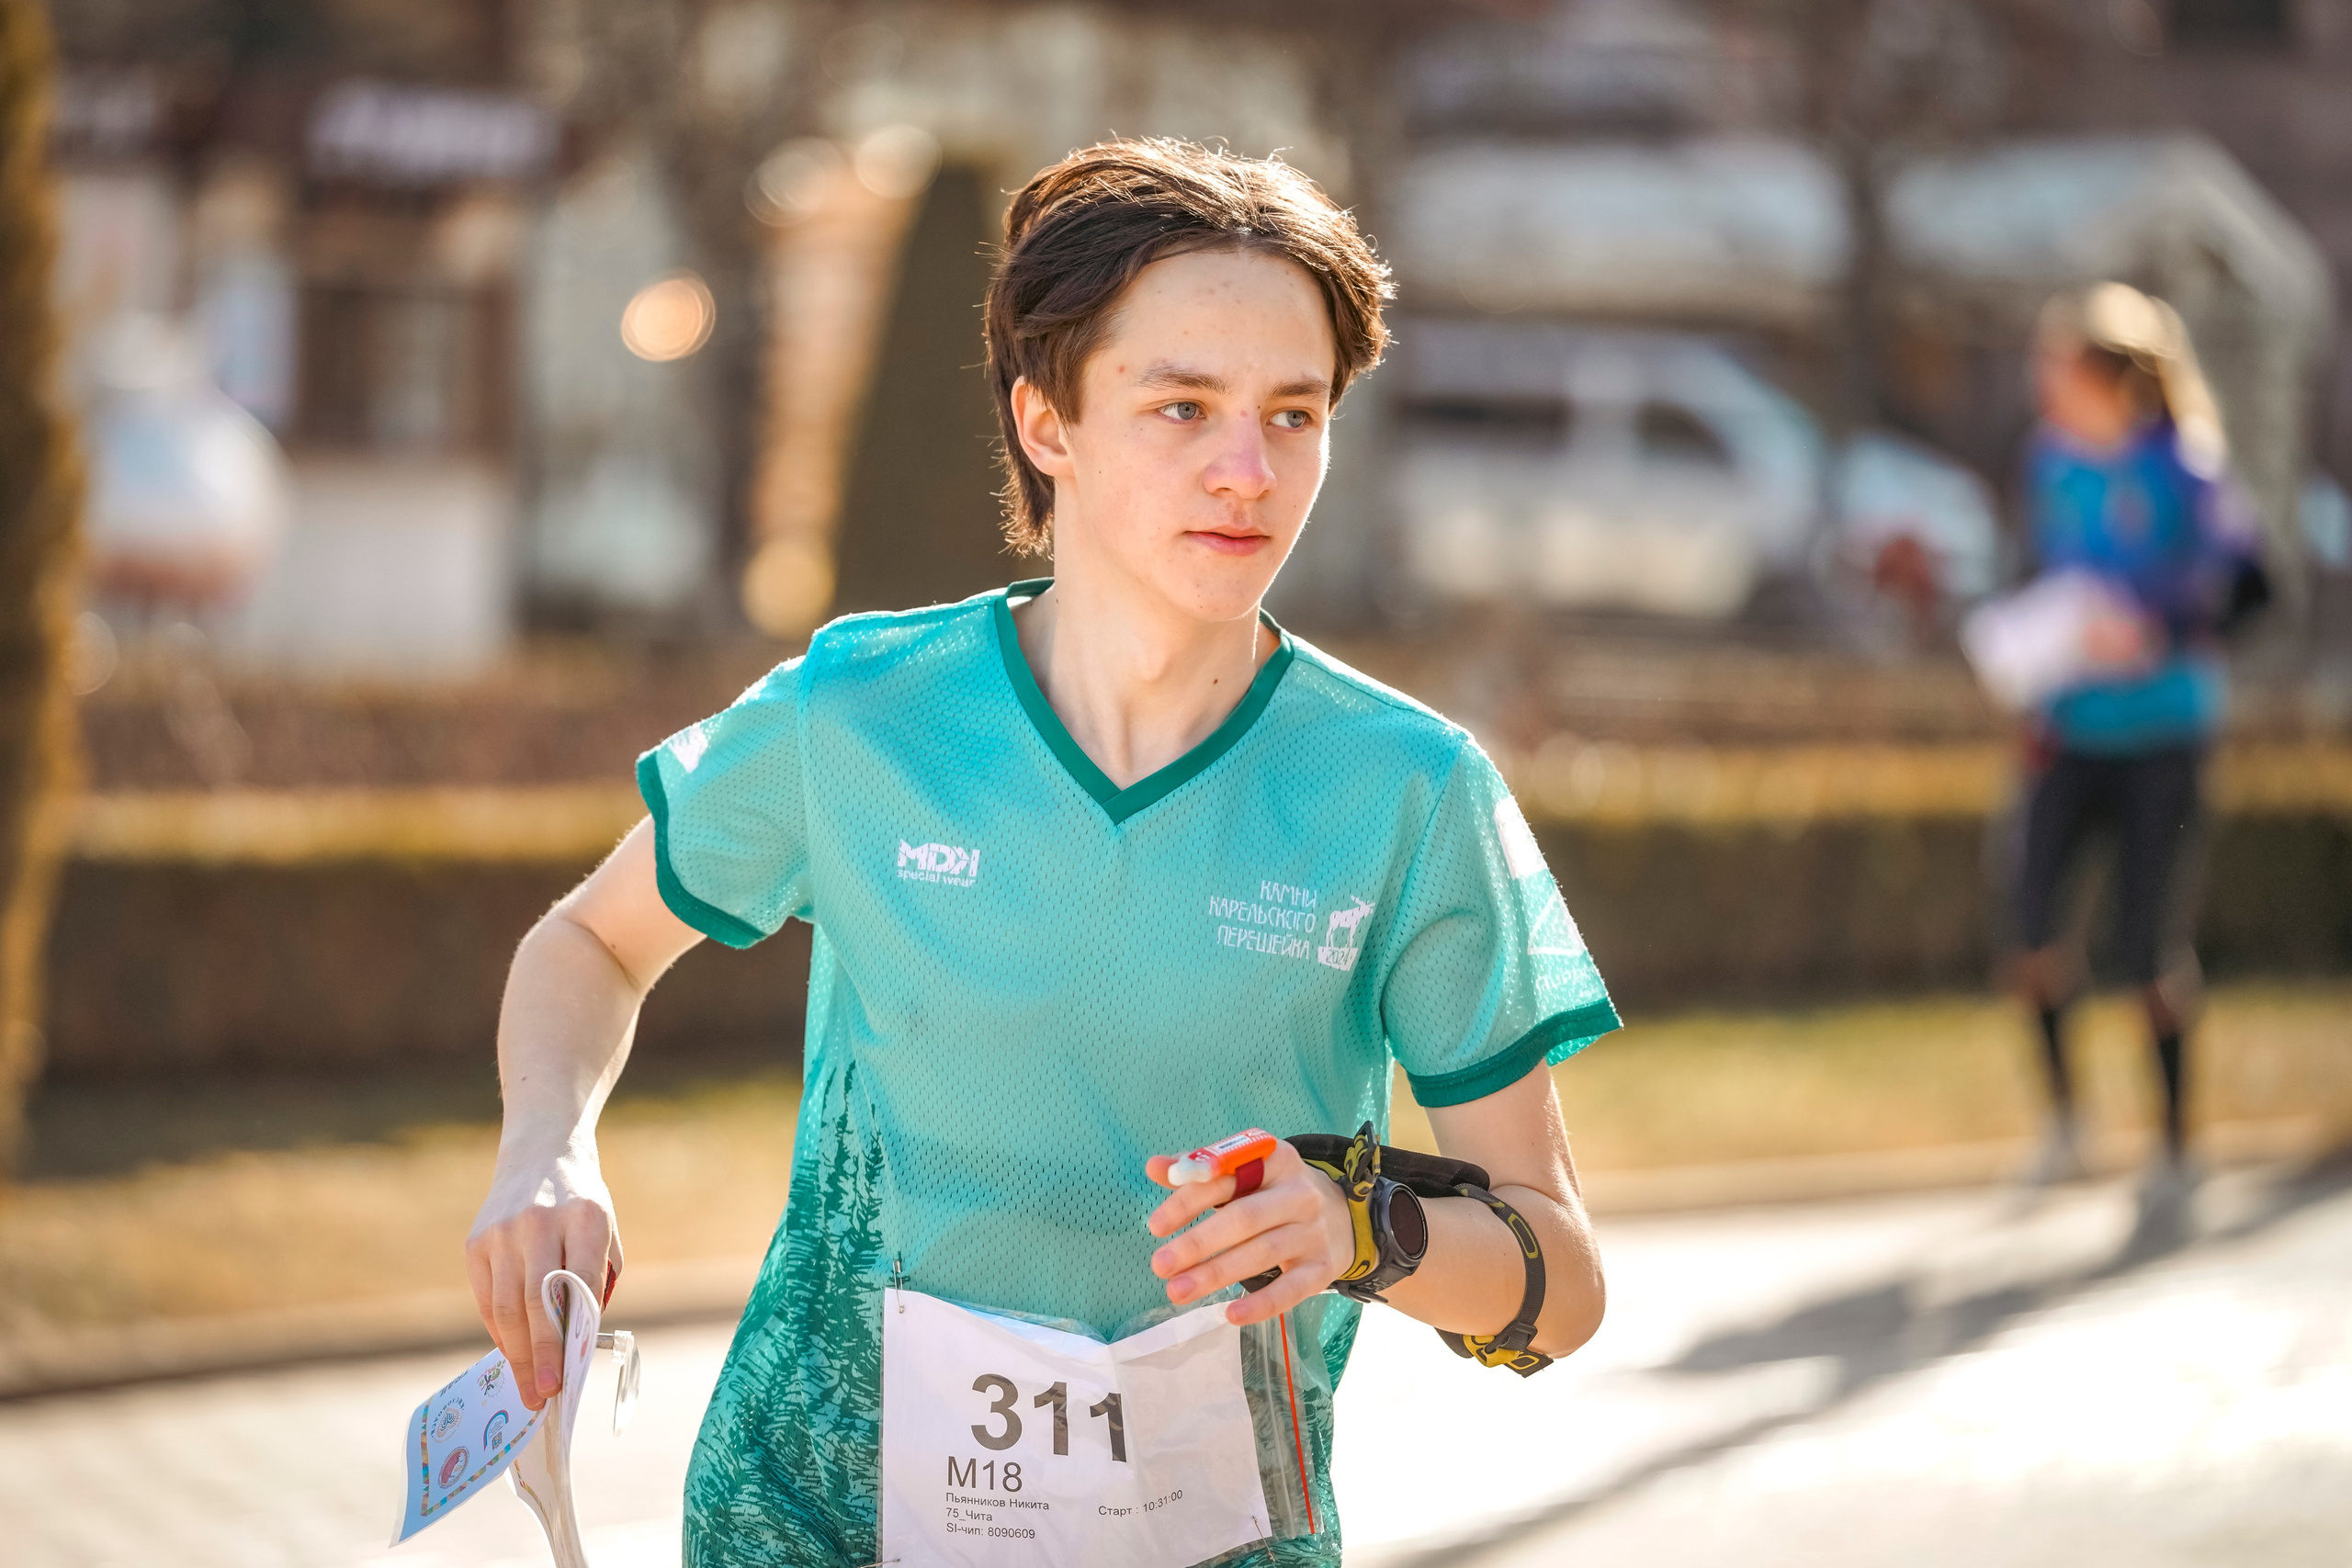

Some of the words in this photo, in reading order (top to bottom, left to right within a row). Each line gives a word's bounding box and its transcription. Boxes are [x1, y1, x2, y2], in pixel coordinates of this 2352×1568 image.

[897, 869, 939, 883] special
[943, 875, 976, 887] wear
[1260, 879, 1317, 908] КАМНИ
[1208, 895, 1317, 933] КАРЕЛЬСКОГО
[1216, 924, 1310, 960] ПЕРЕШЕЙКА
[1326, 949, 1350, 965] 2024
[970, 1372, 1127, 1462] 311
[945, 1492, 1006, 1507] Пьянников
[1009, 1498, 1050, 1511] Никита
[1098, 1506, 1133, 1517] Старт
[1143, 1489, 1183, 1512] 10:31:00
[945, 1507, 993, 1522] 75_Чита
[946, 1522, 984, 1536] SI-чип:
[987, 1527, 1035, 1539] 8090609
